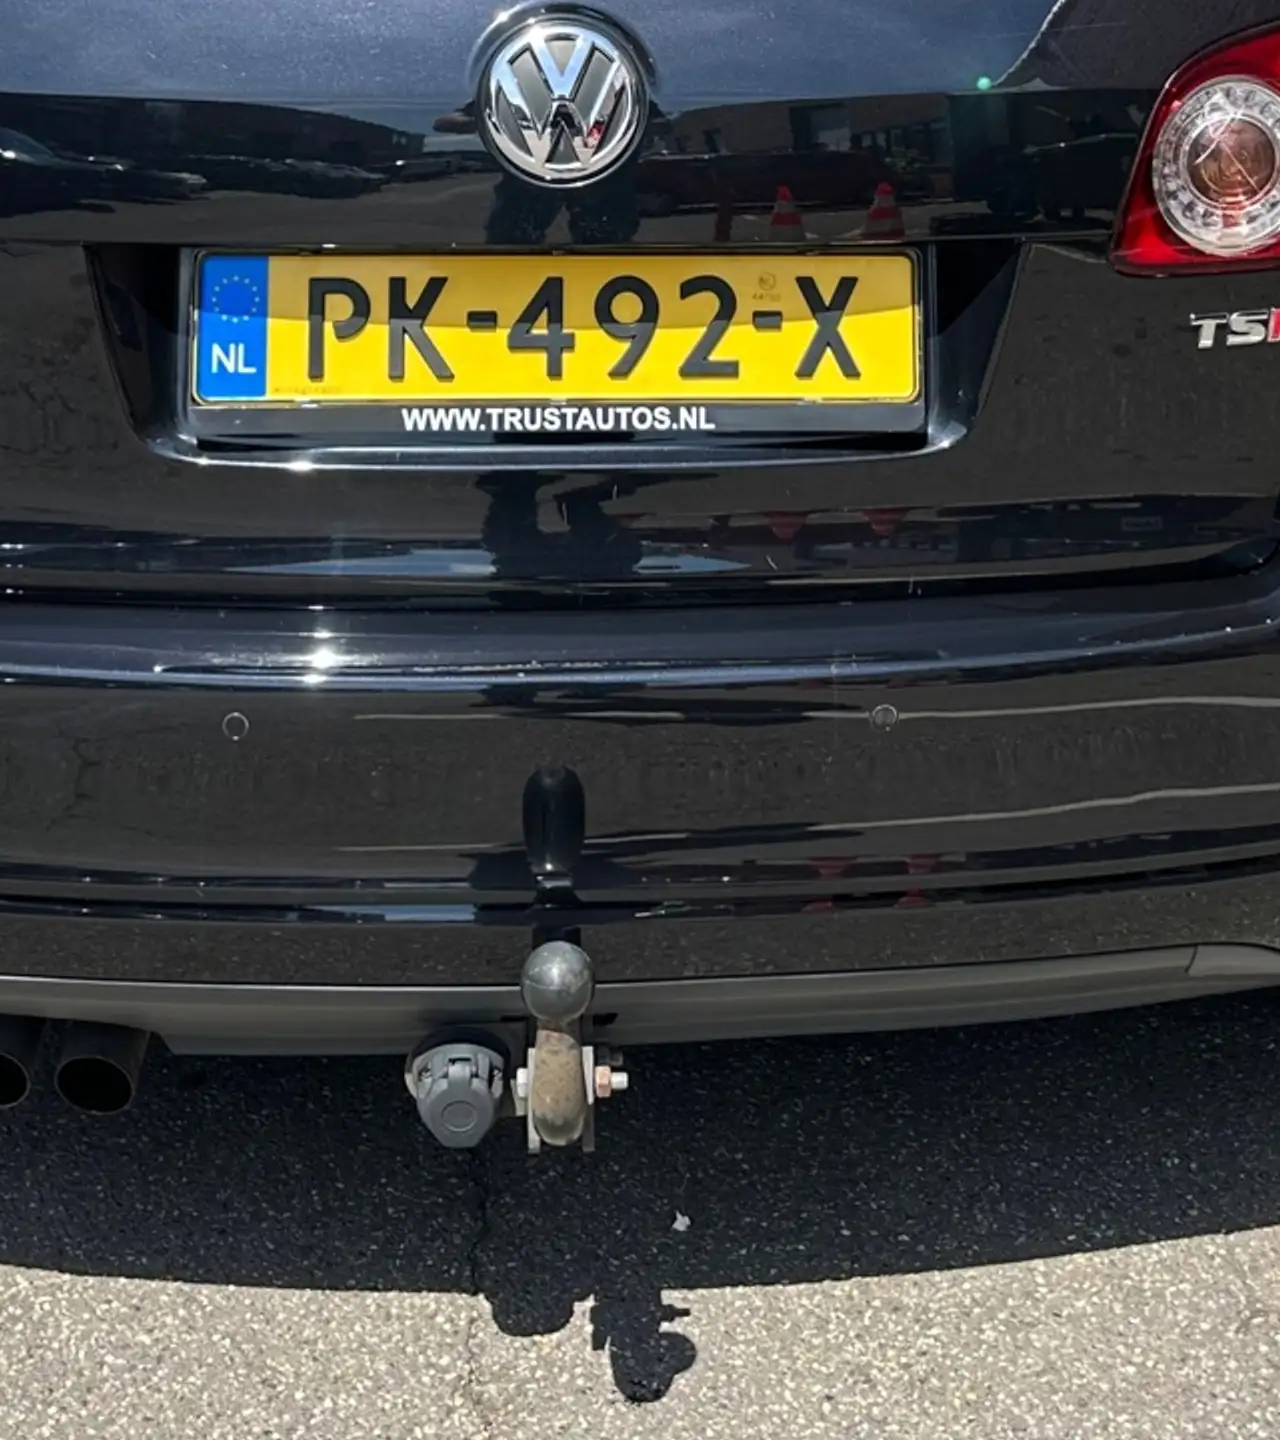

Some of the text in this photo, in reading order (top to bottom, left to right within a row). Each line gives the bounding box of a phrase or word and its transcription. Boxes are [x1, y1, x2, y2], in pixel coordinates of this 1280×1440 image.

[211, 275, 862, 382] NL PK-492-X
[401, 405, 716, 432] WWW.TRUSTAUTOS.NL
